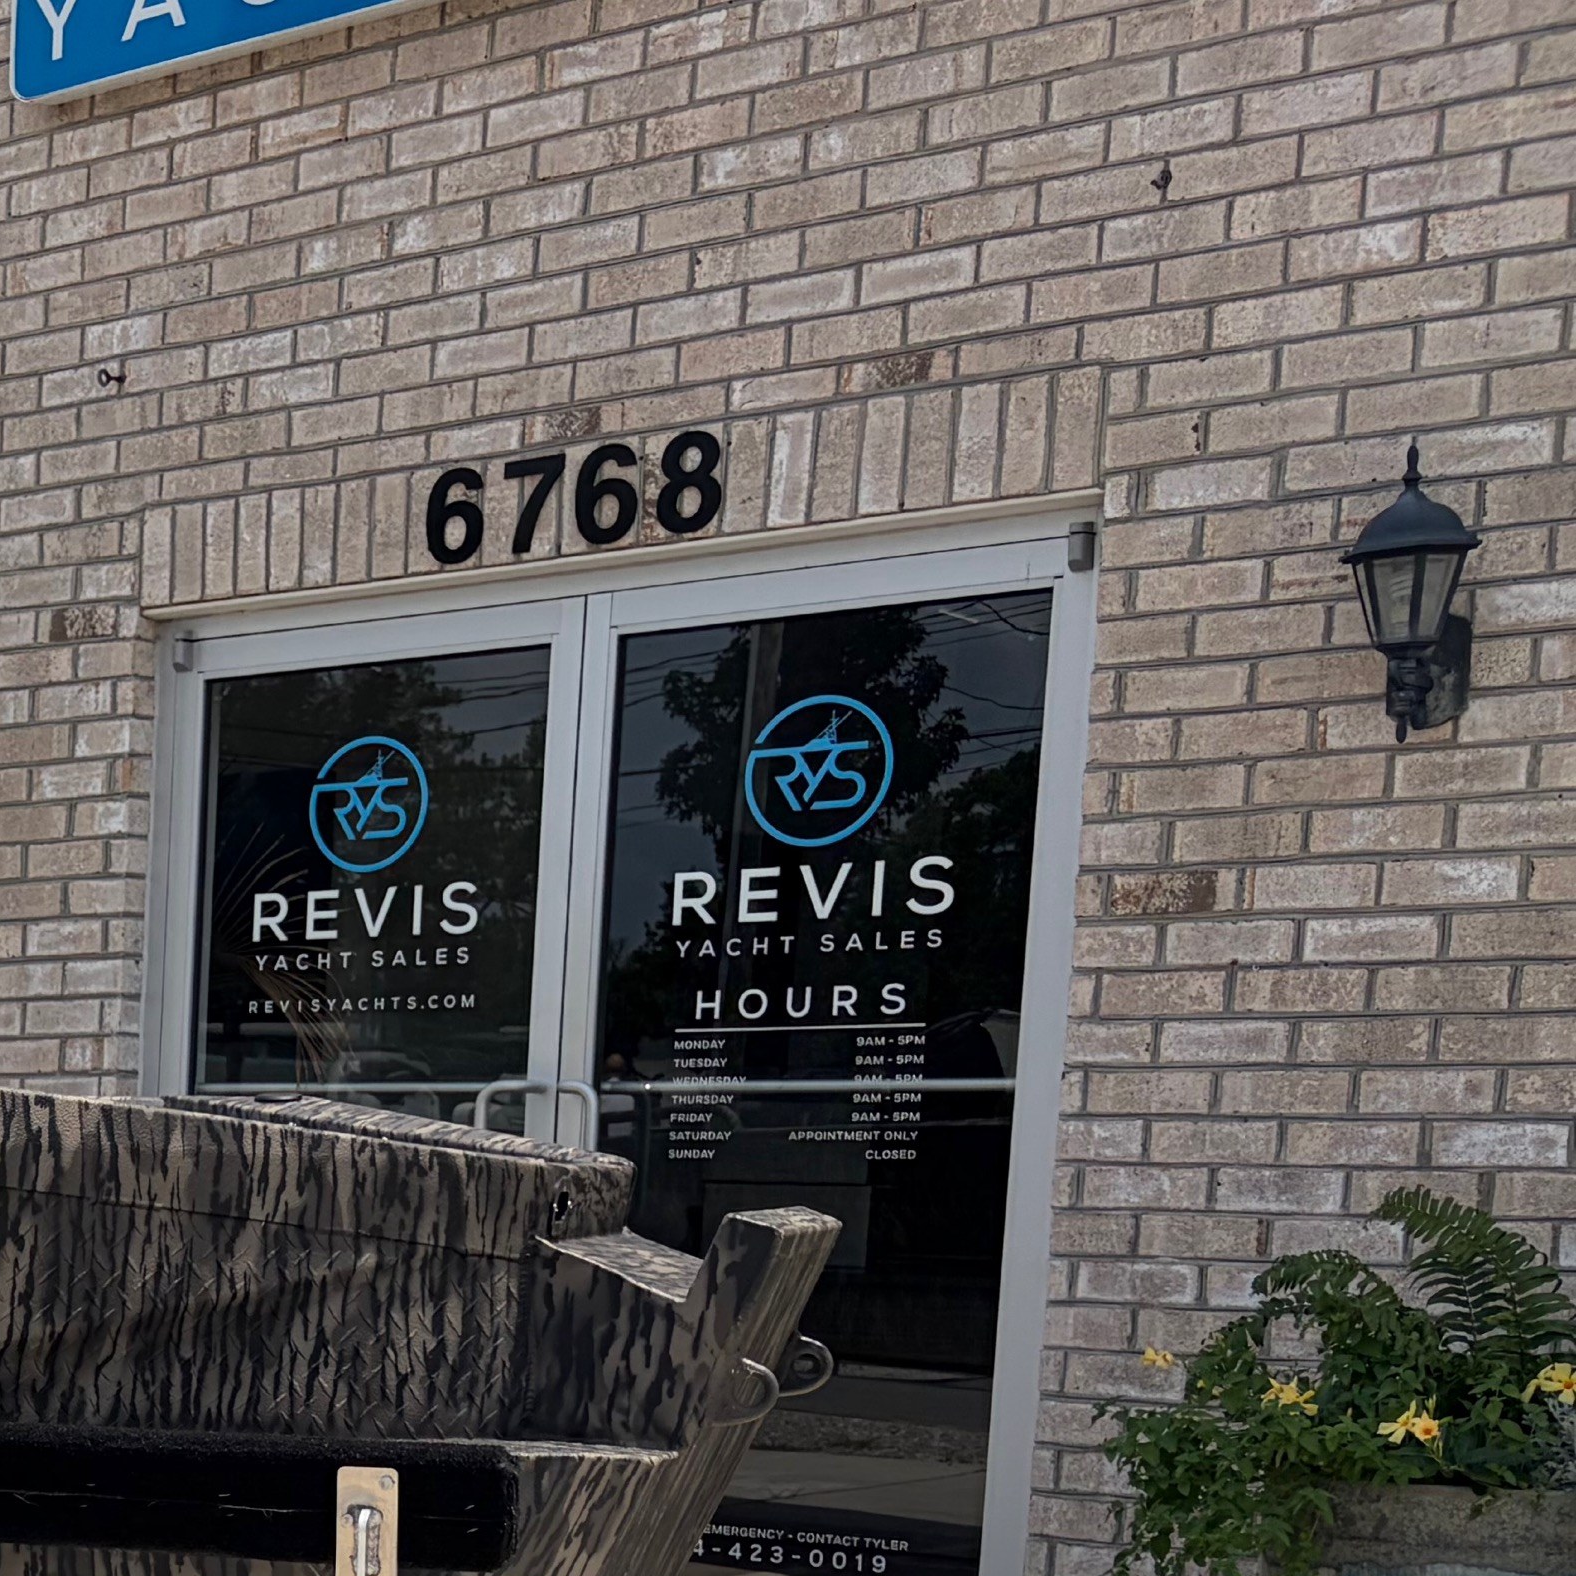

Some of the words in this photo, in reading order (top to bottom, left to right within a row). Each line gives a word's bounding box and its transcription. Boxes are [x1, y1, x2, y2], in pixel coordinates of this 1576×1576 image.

[38, 0, 278, 61] YA
[426, 430, 723, 565] 6768
[673, 855, 955, 926] REVIS
[251, 881, 479, 942] REVIS
[676, 935, 795, 958] YACHT
[819, 929, 943, 952] SALES
[255, 952, 353, 971] YACHT
[371, 946, 470, 967] SALES
[248, 994, 476, 1014] REVISYACHTS.COM
[695, 983, 906, 1020] HOURS
[674, 1039, 726, 1050] MONDAY
[856, 1036, 886, 1047] 9AM
[897, 1034, 926, 1046] 5PM
[673, 1058, 728, 1068] TUESDAY
[855, 1055, 884, 1065] 9AM
[896, 1054, 925, 1065] 5PM
[673, 1075, 747, 1085] WEDNESDAY
[671, 1094, 734, 1105] THURSDAY
[852, 1093, 882, 1103] 9AM
[894, 1092, 922, 1103] 5PM
[670, 1113, 713, 1123] FRIDAY
[851, 1112, 881, 1122] 9AM
[892, 1111, 921, 1122] 5PM
[669, 1130, 732, 1141] SATURDAY
[788, 1130, 881, 1141] APPOINTMENT
[884, 1130, 919, 1141] ONLY
[668, 1149, 716, 1159] SUNDAY
[865, 1149, 917, 1160] CLOSED
[702, 1523, 785, 1541] EMERGENCY
[796, 1531, 860, 1548] CONTACT
[863, 1536, 909, 1552] TYLER
